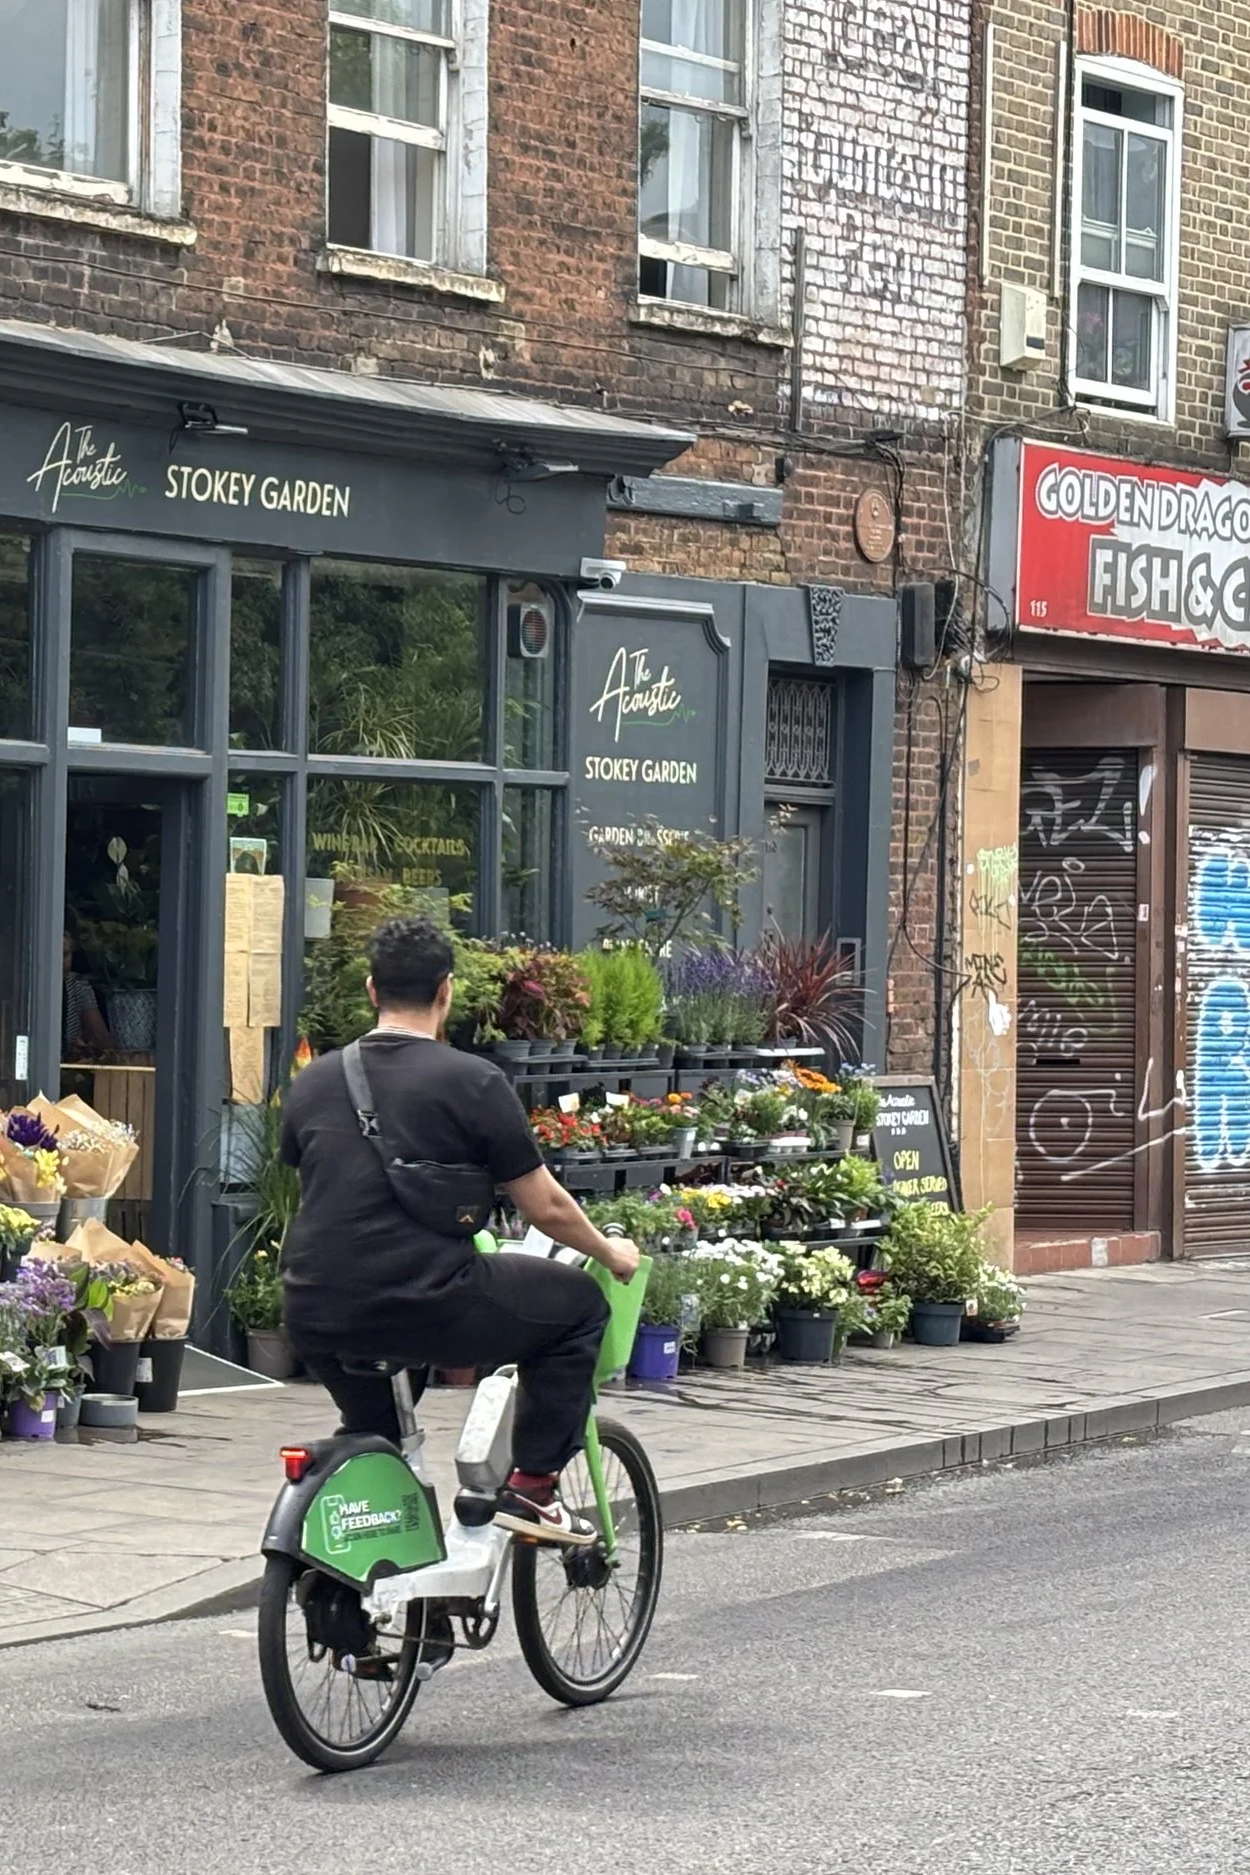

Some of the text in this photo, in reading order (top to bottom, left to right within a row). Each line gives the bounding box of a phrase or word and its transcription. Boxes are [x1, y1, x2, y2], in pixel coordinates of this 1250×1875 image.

[75, 425, 96, 464] The
[27, 421, 127, 513] Acoustic
[165, 465, 350, 518] STOKEY GARDEN
[1030, 600, 1048, 617] 115
[629, 648, 651, 690] The
[589, 647, 681, 743] Acoustic
[585, 756, 698, 785] STOKEY GARDEN
[589, 825, 634, 847] GARDEN
[876, 1111, 902, 1127] STOKEY
[893, 1150, 920, 1171] OPEN
[339, 1500, 370, 1515] HAVE
[341, 1509, 402, 1531] FEEDBACK?
